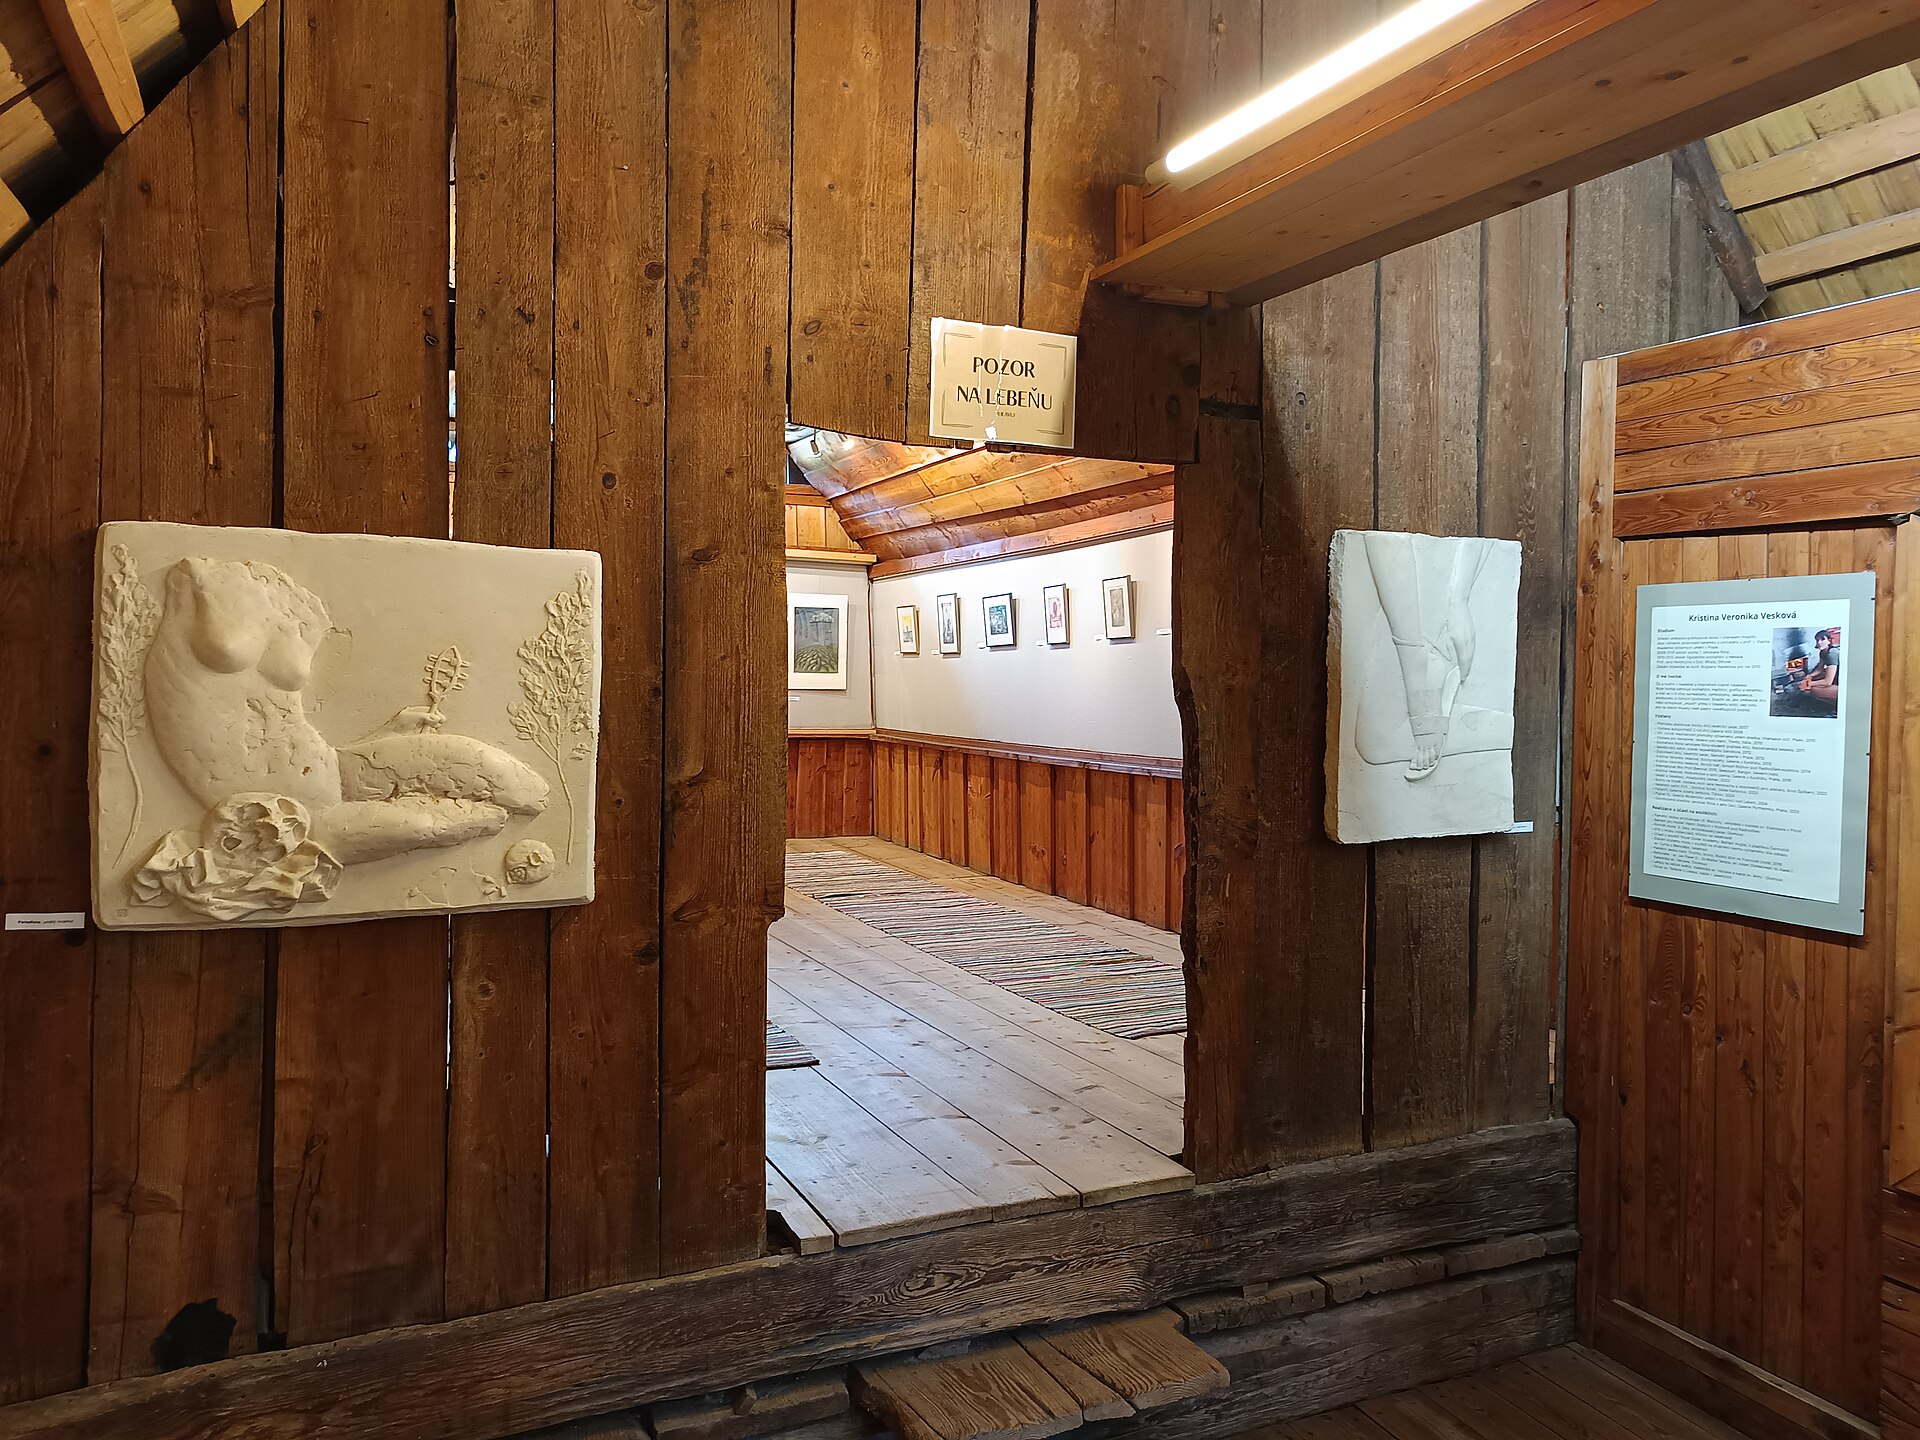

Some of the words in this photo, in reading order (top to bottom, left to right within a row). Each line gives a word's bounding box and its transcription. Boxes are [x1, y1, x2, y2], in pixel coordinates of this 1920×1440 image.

[973, 356, 1035, 378] POZOR
[957, 385, 981, 404] NA
[986, 387, 1052, 410] LEBEŇU
[1689, 614, 1719, 622] Kristina
[1721, 613, 1758, 621] Veronika
[1760, 611, 1797, 620] Vesková
